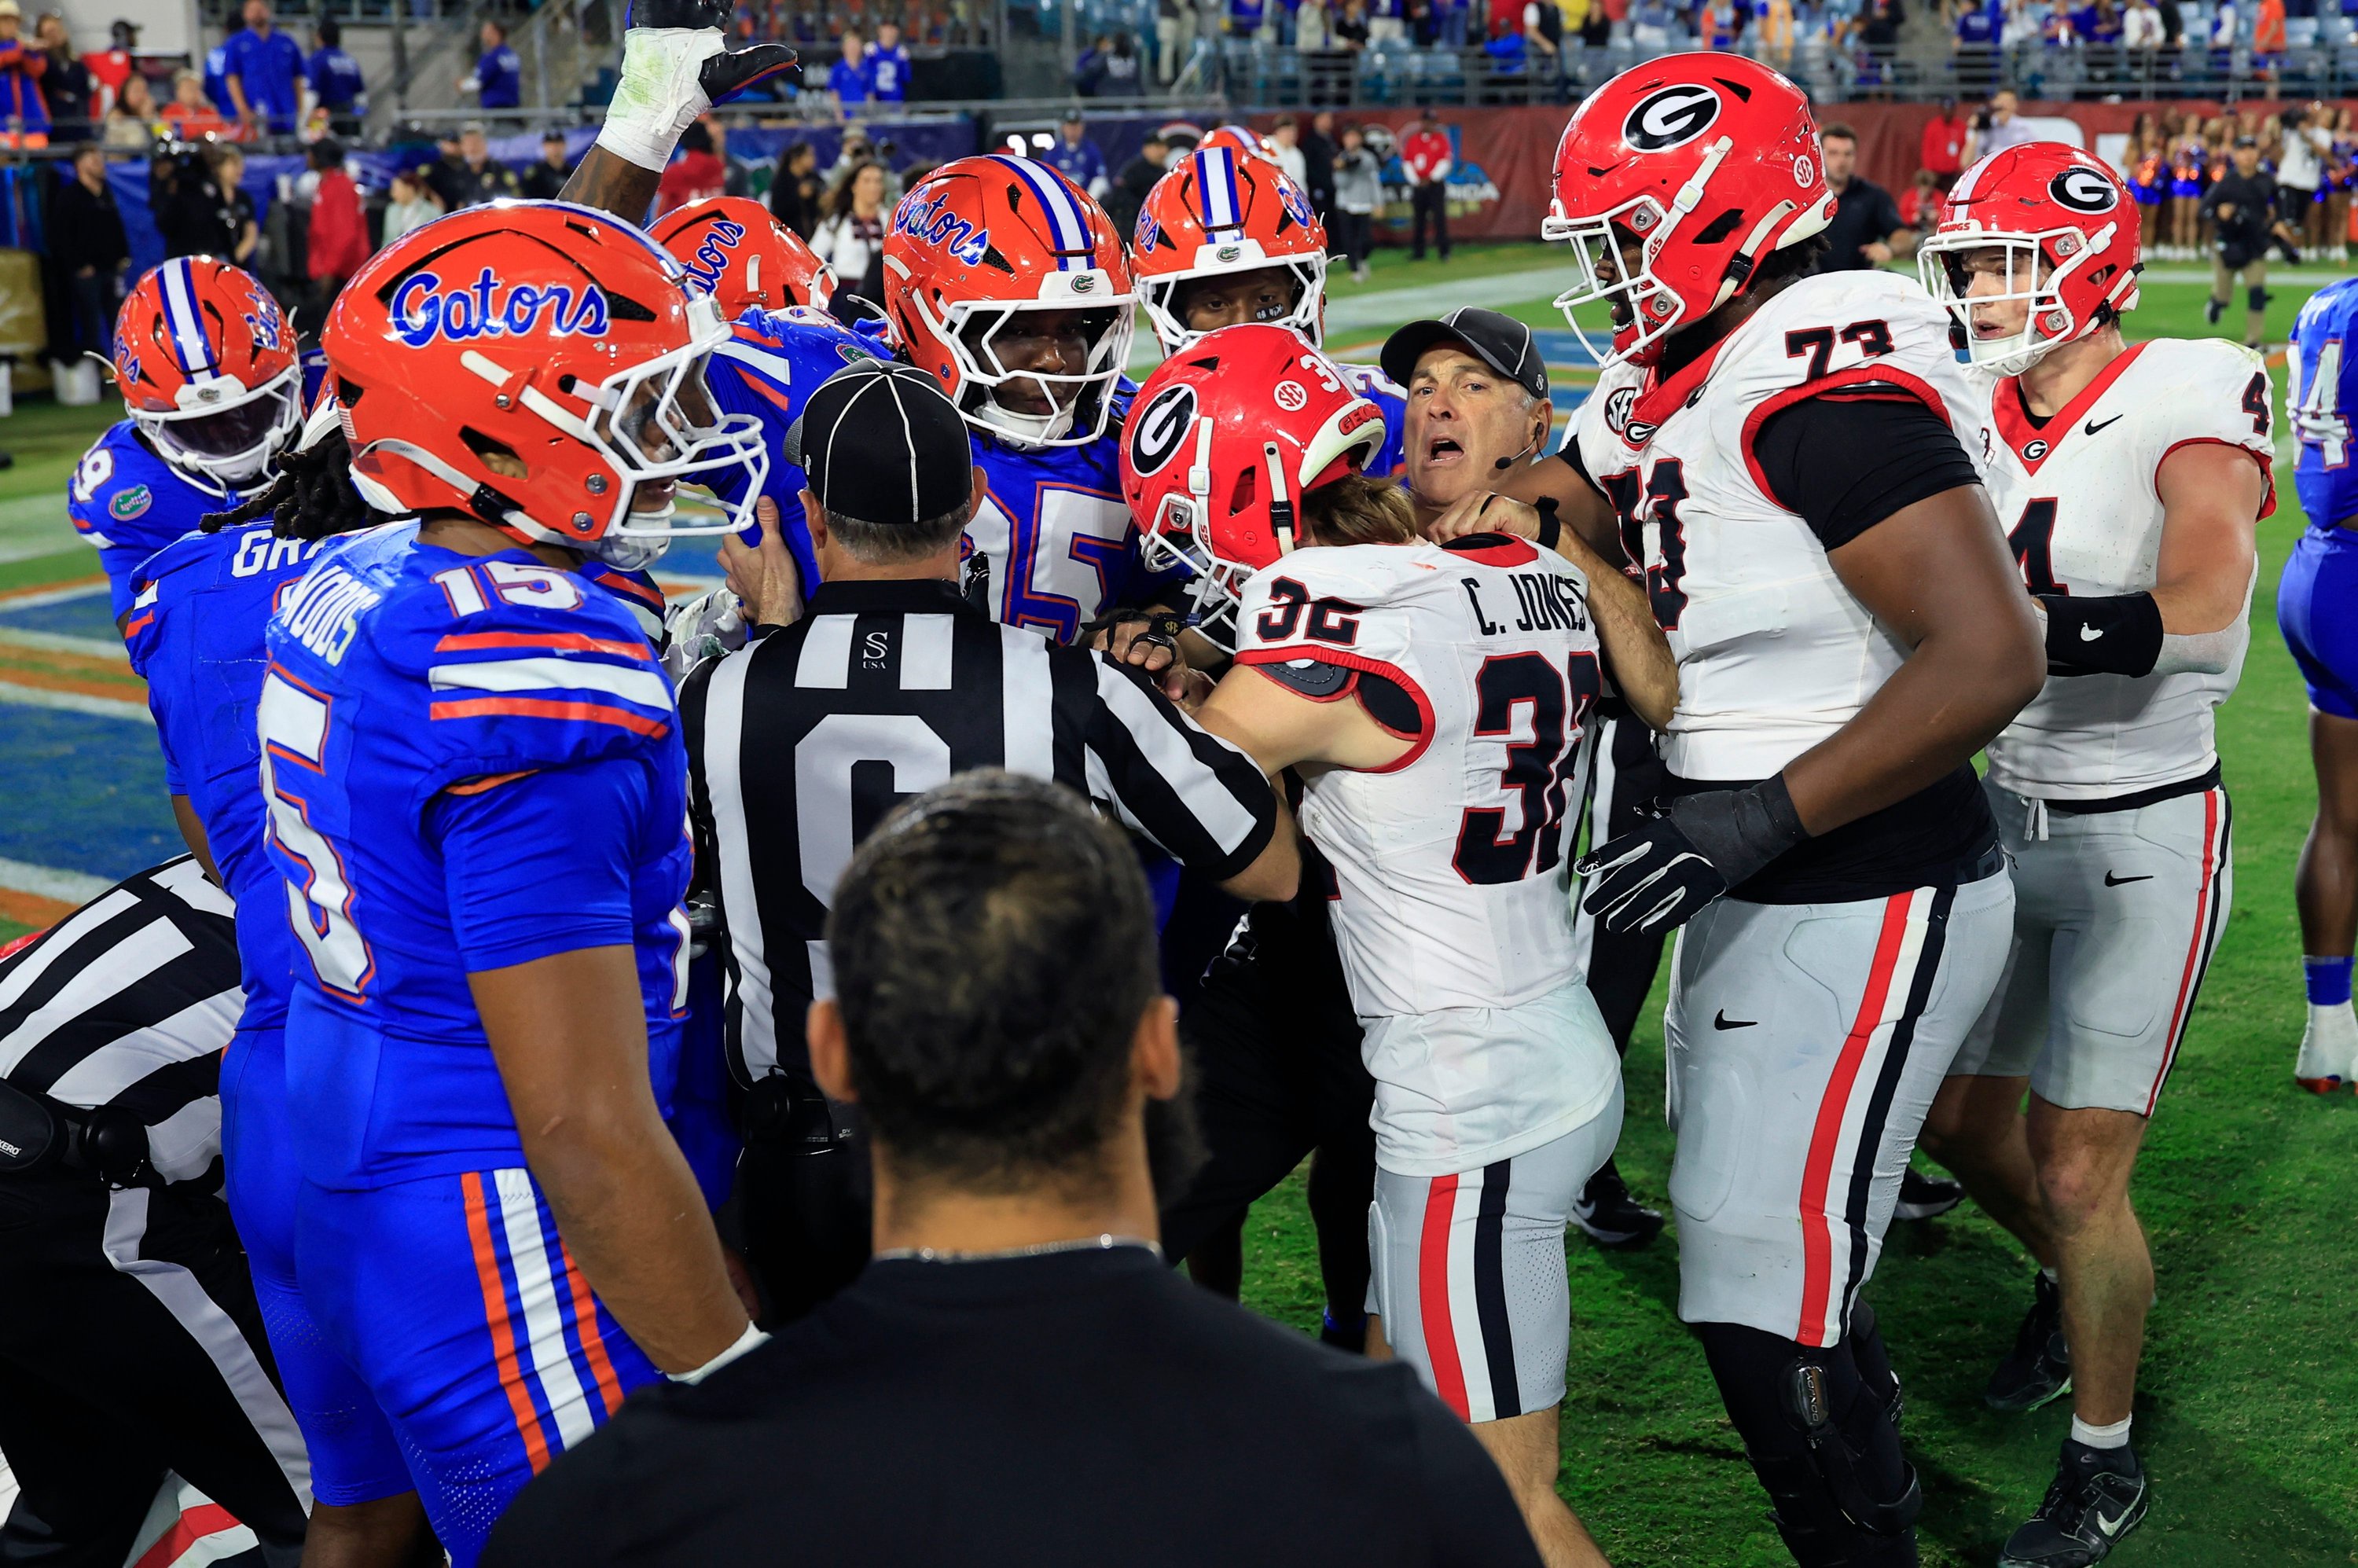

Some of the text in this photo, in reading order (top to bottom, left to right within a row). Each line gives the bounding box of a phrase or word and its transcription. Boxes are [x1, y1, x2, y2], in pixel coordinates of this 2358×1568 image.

[1796, 159, 1812, 185] SEC
[895, 183, 990, 267] Gators
[391, 266, 608, 349] Gators
[1785, 319, 1895, 382] 73
[1276, 384, 1304, 409] SEC
[1605, 387, 1638, 433] SE
[2242, 372, 2270, 437] 4
[2007, 497, 2069, 597] 4
[281, 565, 382, 666] WOODS
[431, 560, 582, 618] 15
[1256, 575, 1364, 645] 32
[1461, 572, 1588, 636] C. JONES
[1452, 651, 1602, 885] 32
